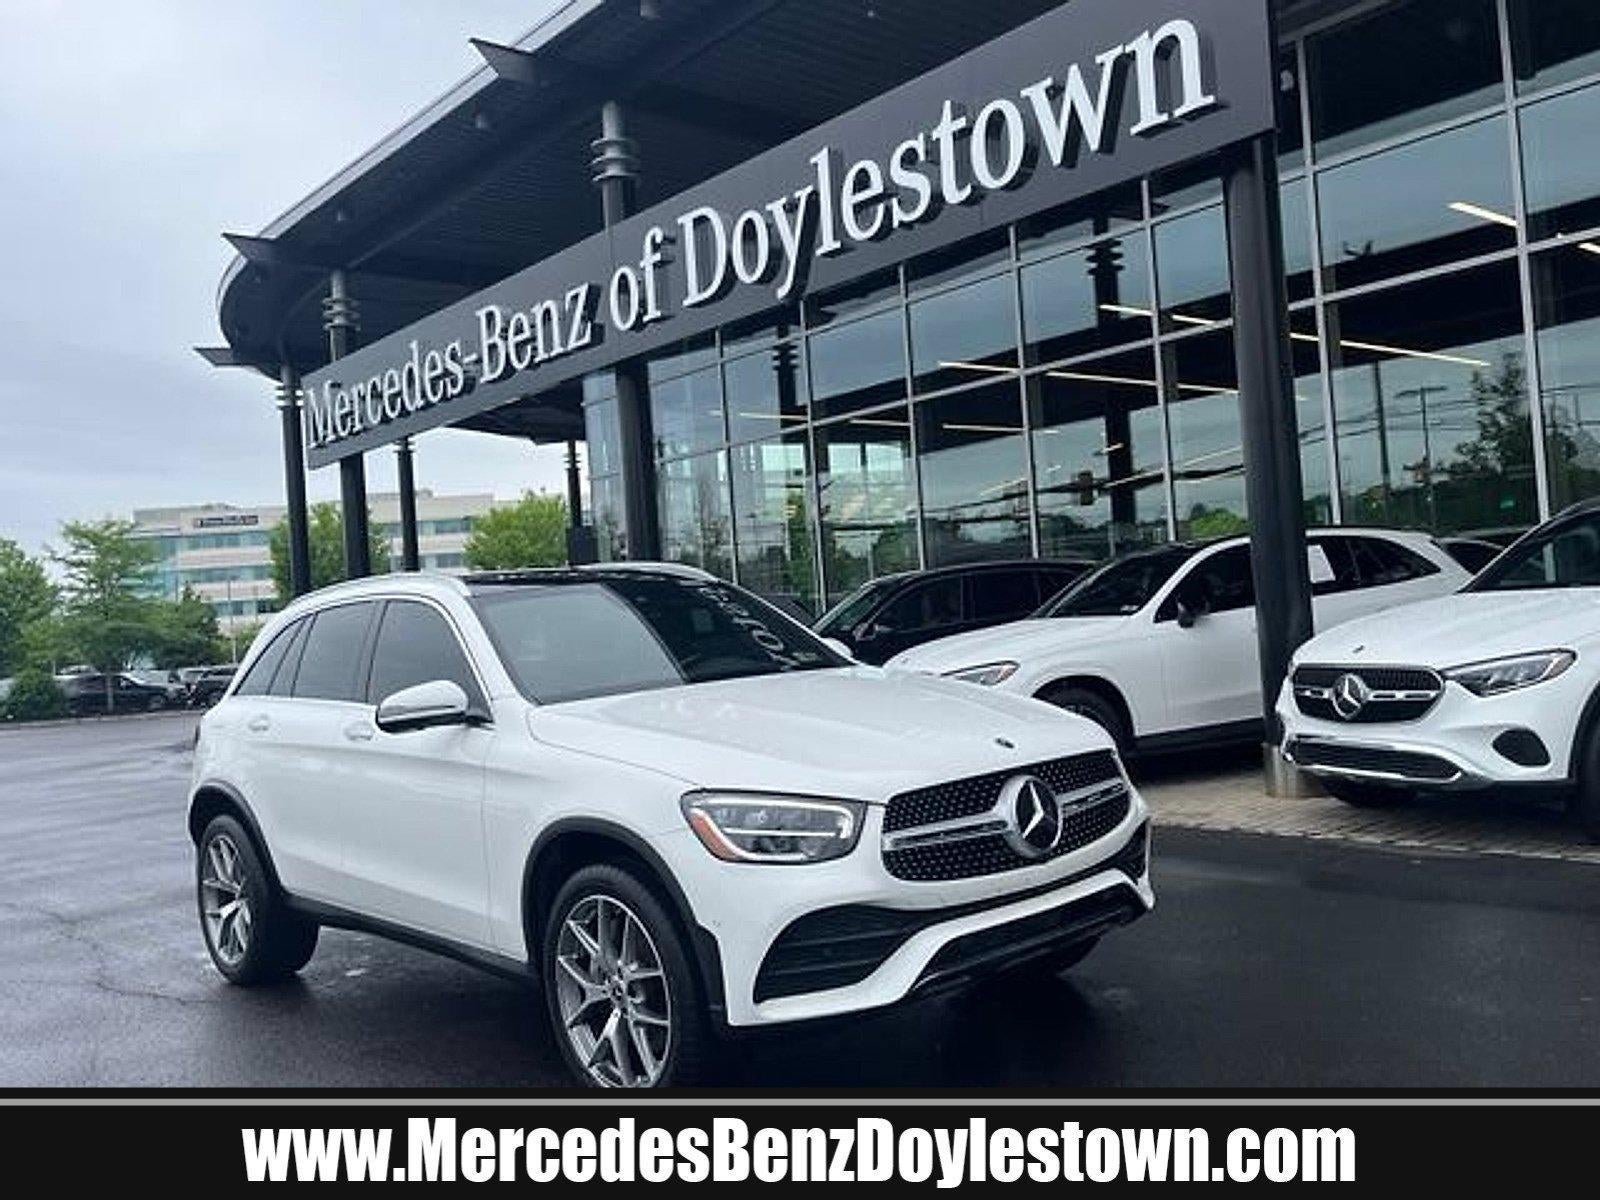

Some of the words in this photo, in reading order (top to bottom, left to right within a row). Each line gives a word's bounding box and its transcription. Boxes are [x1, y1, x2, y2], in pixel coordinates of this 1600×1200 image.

[305, 283, 592, 448] Mercedes-Benz
[609, 226, 664, 332] of
[677, 18, 1217, 308] Doylestown
